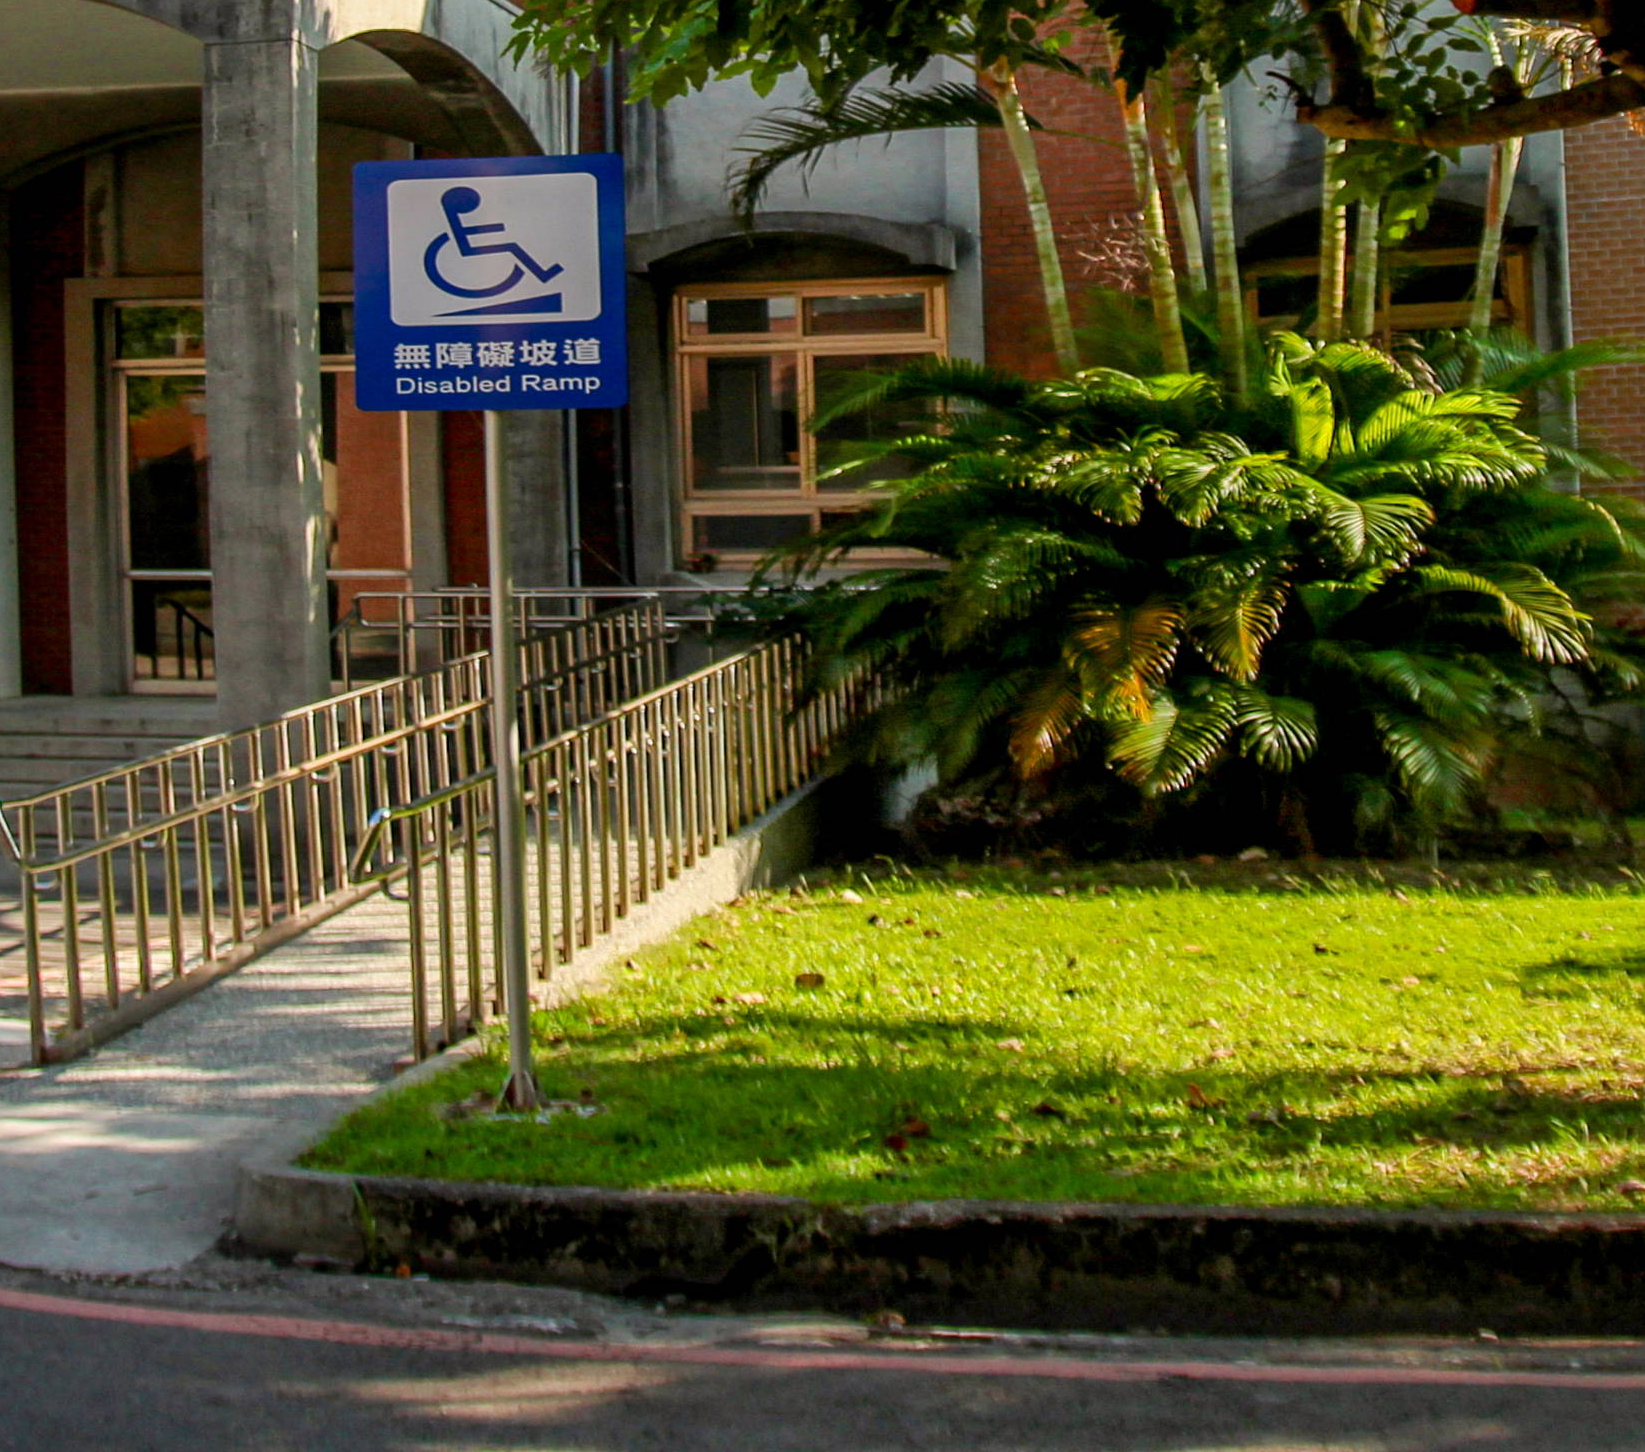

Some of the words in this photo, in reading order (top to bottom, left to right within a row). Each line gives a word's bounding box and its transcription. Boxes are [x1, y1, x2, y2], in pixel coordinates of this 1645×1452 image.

[394, 338, 601, 369] 無障礙坡道
[396, 376, 511, 395] Disabled
[521, 374, 601, 394] Ramp
